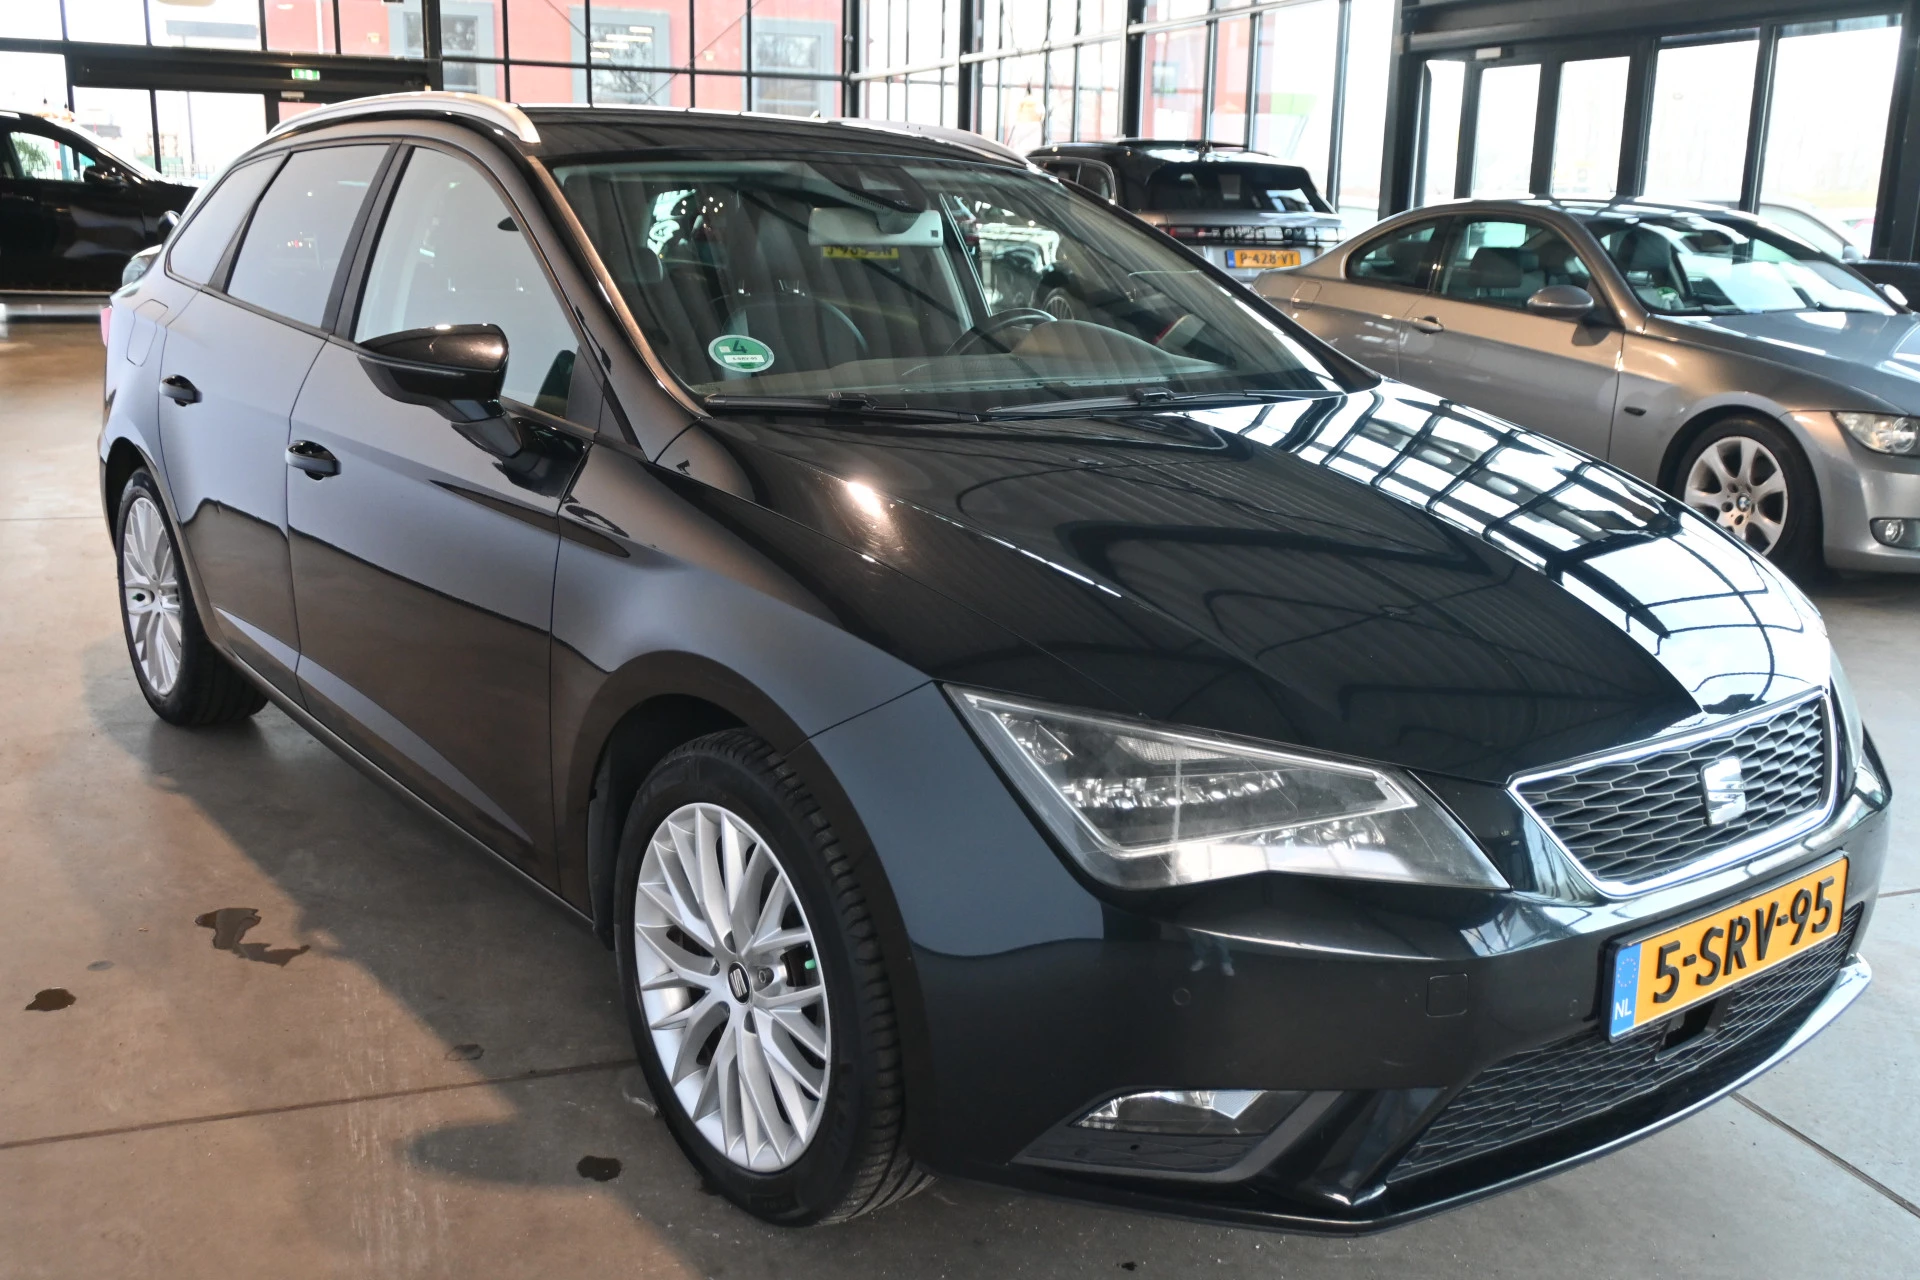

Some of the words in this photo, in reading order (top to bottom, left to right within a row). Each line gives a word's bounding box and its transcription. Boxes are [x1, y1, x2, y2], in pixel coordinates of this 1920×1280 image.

[1239, 251, 1296, 266] P-428-VT
[732, 340, 748, 354] 4
[1652, 875, 1835, 1004] 5-SRV-95
[1614, 997, 1632, 1021] NL
